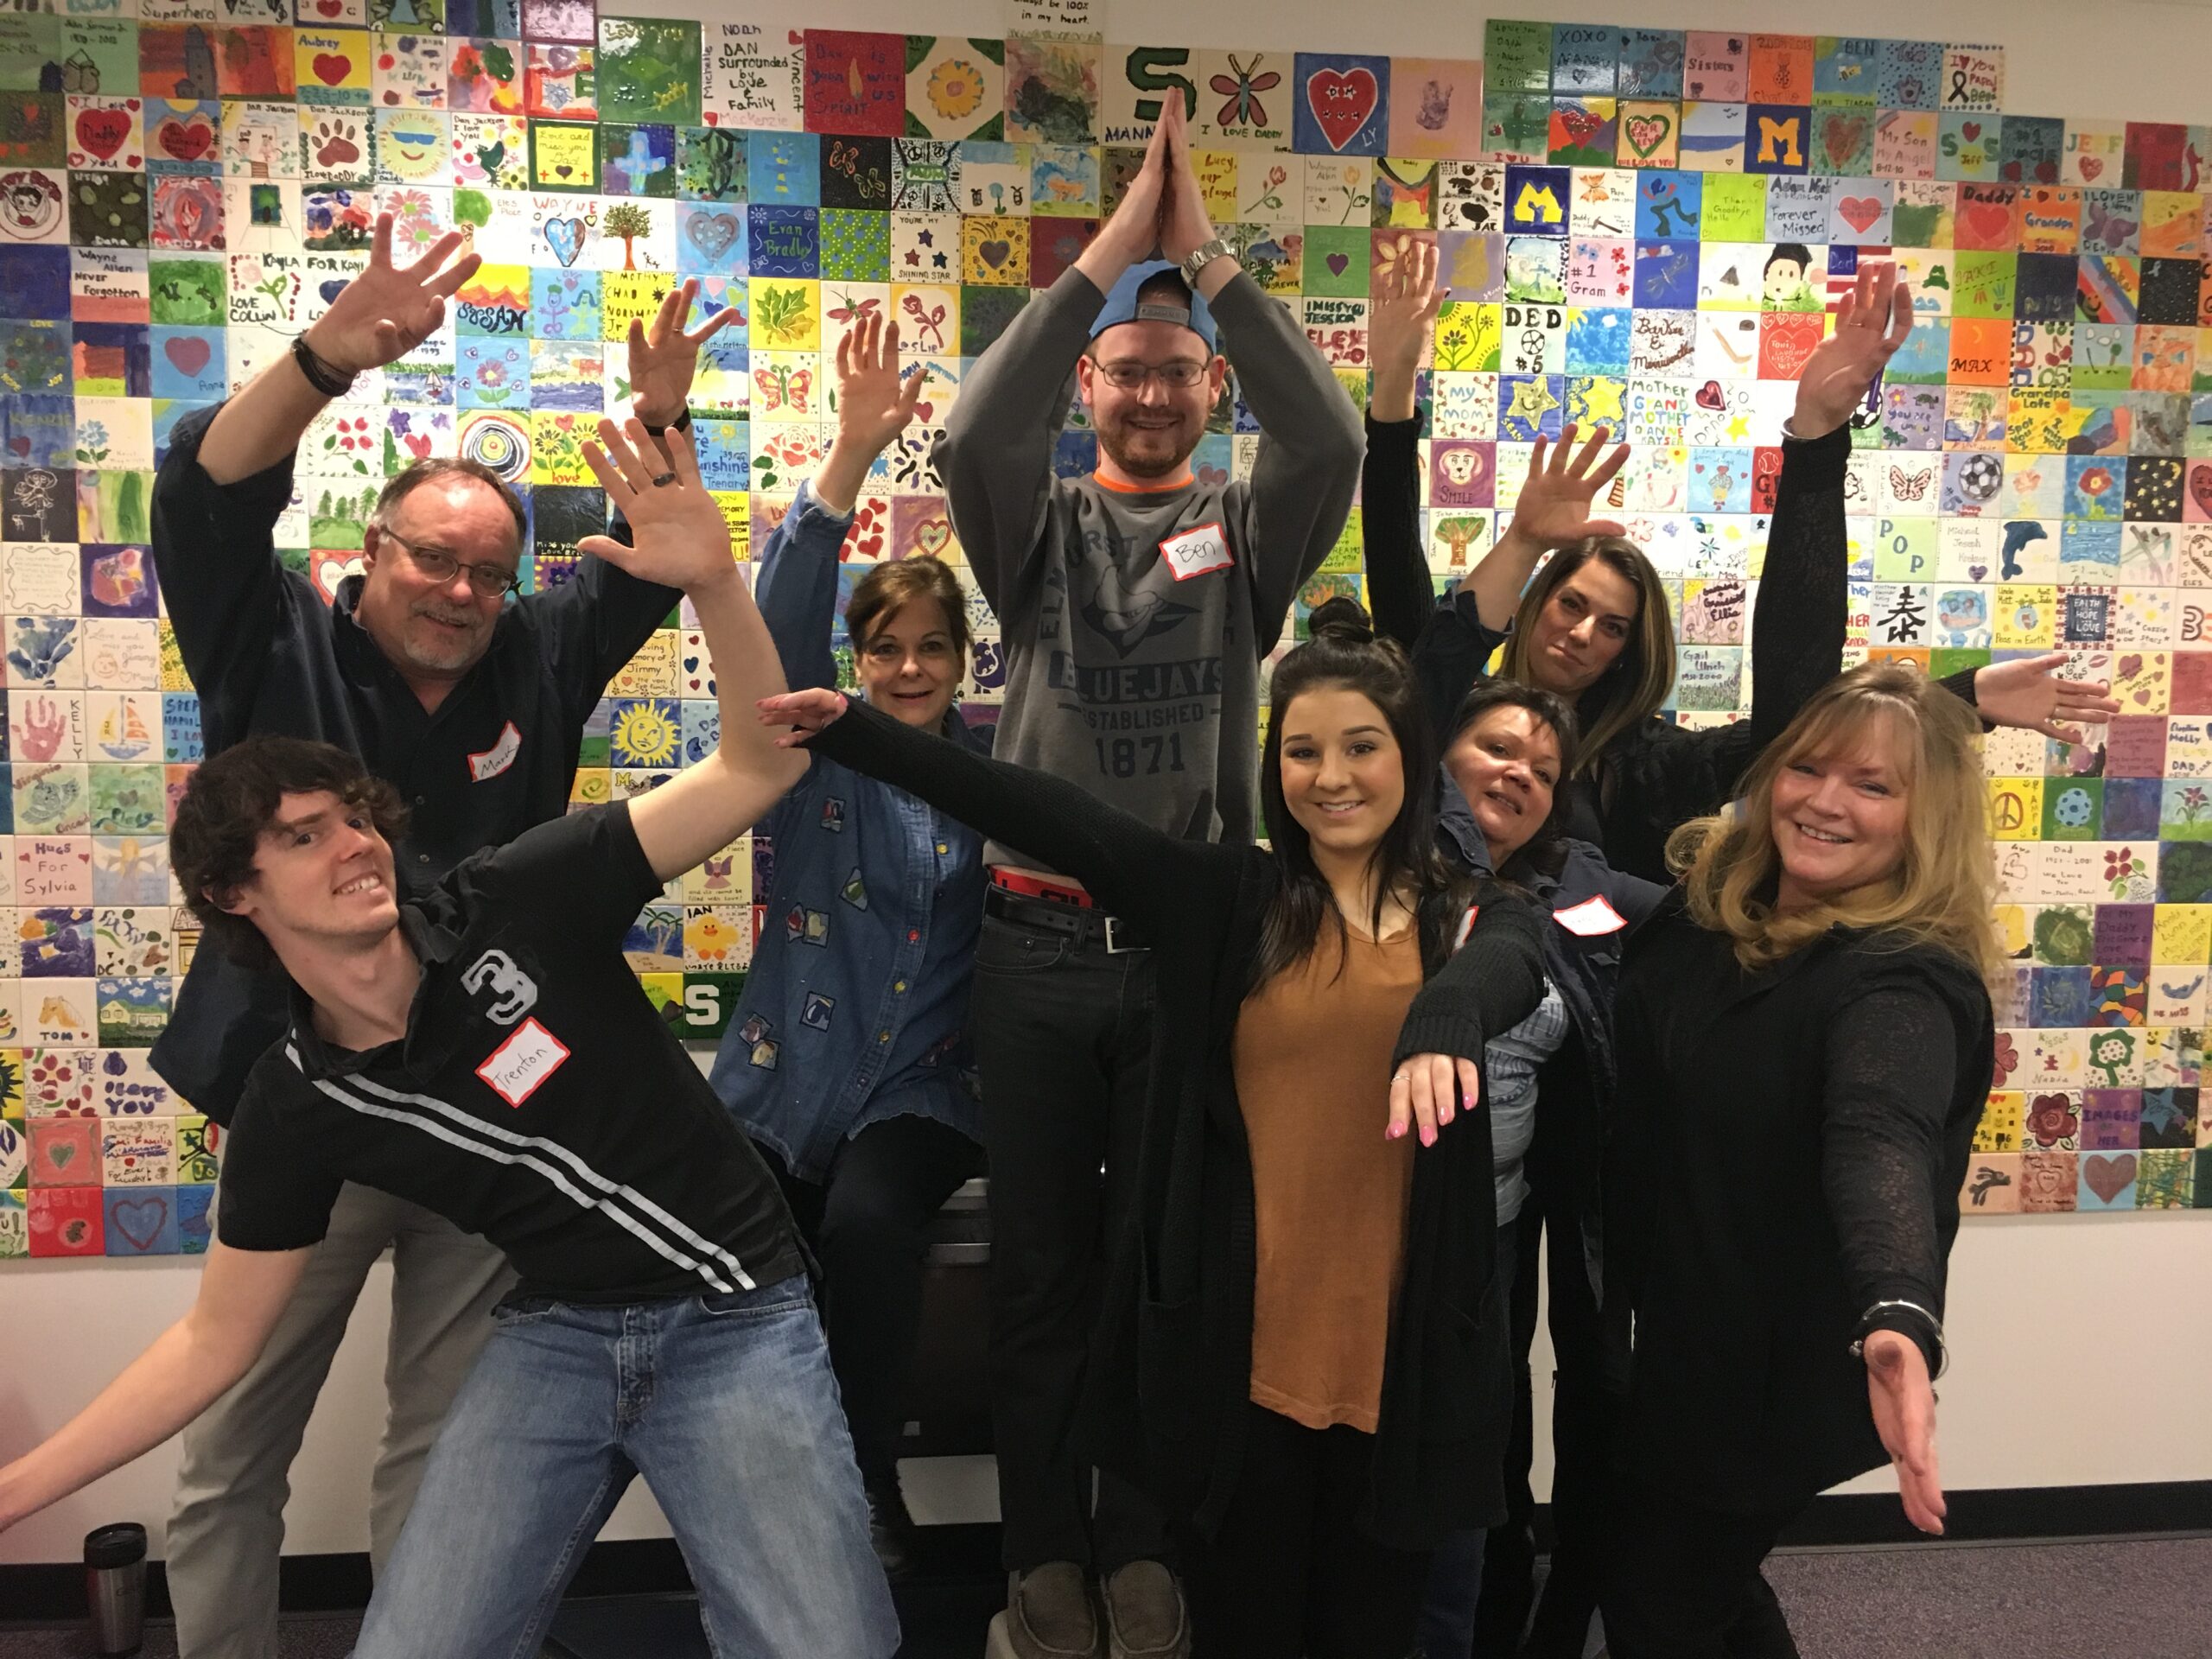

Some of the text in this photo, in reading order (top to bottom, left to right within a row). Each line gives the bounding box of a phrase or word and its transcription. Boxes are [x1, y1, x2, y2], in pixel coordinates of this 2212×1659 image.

[1021, 10, 1032, 19] in
[298, 35, 340, 49] Aubrey
[1559, 29, 1607, 45] XOXO
[718, 56, 789, 68] Surrounded
[1687, 58, 1734, 73] Sisters
[728, 97, 775, 111] Family
[1758, 117, 1802, 167] M
[1513, 181, 1563, 223] M
[1963, 186, 2015, 205] Daddy
[1771, 207, 1818, 221] Forever
[767, 220, 804, 237] Evan
[78, 249, 118, 262] Wayne
[1570, 283, 1607, 297] Gram
[229, 296, 260, 309] LOVE
[1504, 306, 1563, 330] DED
[1950, 358, 1993, 372] MAX
[2010, 388, 2070, 401] Grandpa
[1439, 486, 1473, 505] SMILE
[1175, 541, 1217, 563] Ben
[2074, 598, 2101, 607] FAITH
[2075, 612, 2098, 621] HOPE
[2076, 622, 2101, 633] LOVE
[626, 662, 661, 676] Jimmy
[1083, 702, 1205, 730] STABLISHED
[1096, 731, 1185, 779] 1871
[2171, 760, 2196, 771] DAD
[38, 861, 68, 873] For
[24, 880, 78, 899] Sylvia
[686, 905, 713, 919] IAN
[460, 950, 537, 1026] 3
[684, 983, 720, 1027] S
[491, 1046, 549, 1090] Trenton
[105, 1097, 156, 1116] YOU
